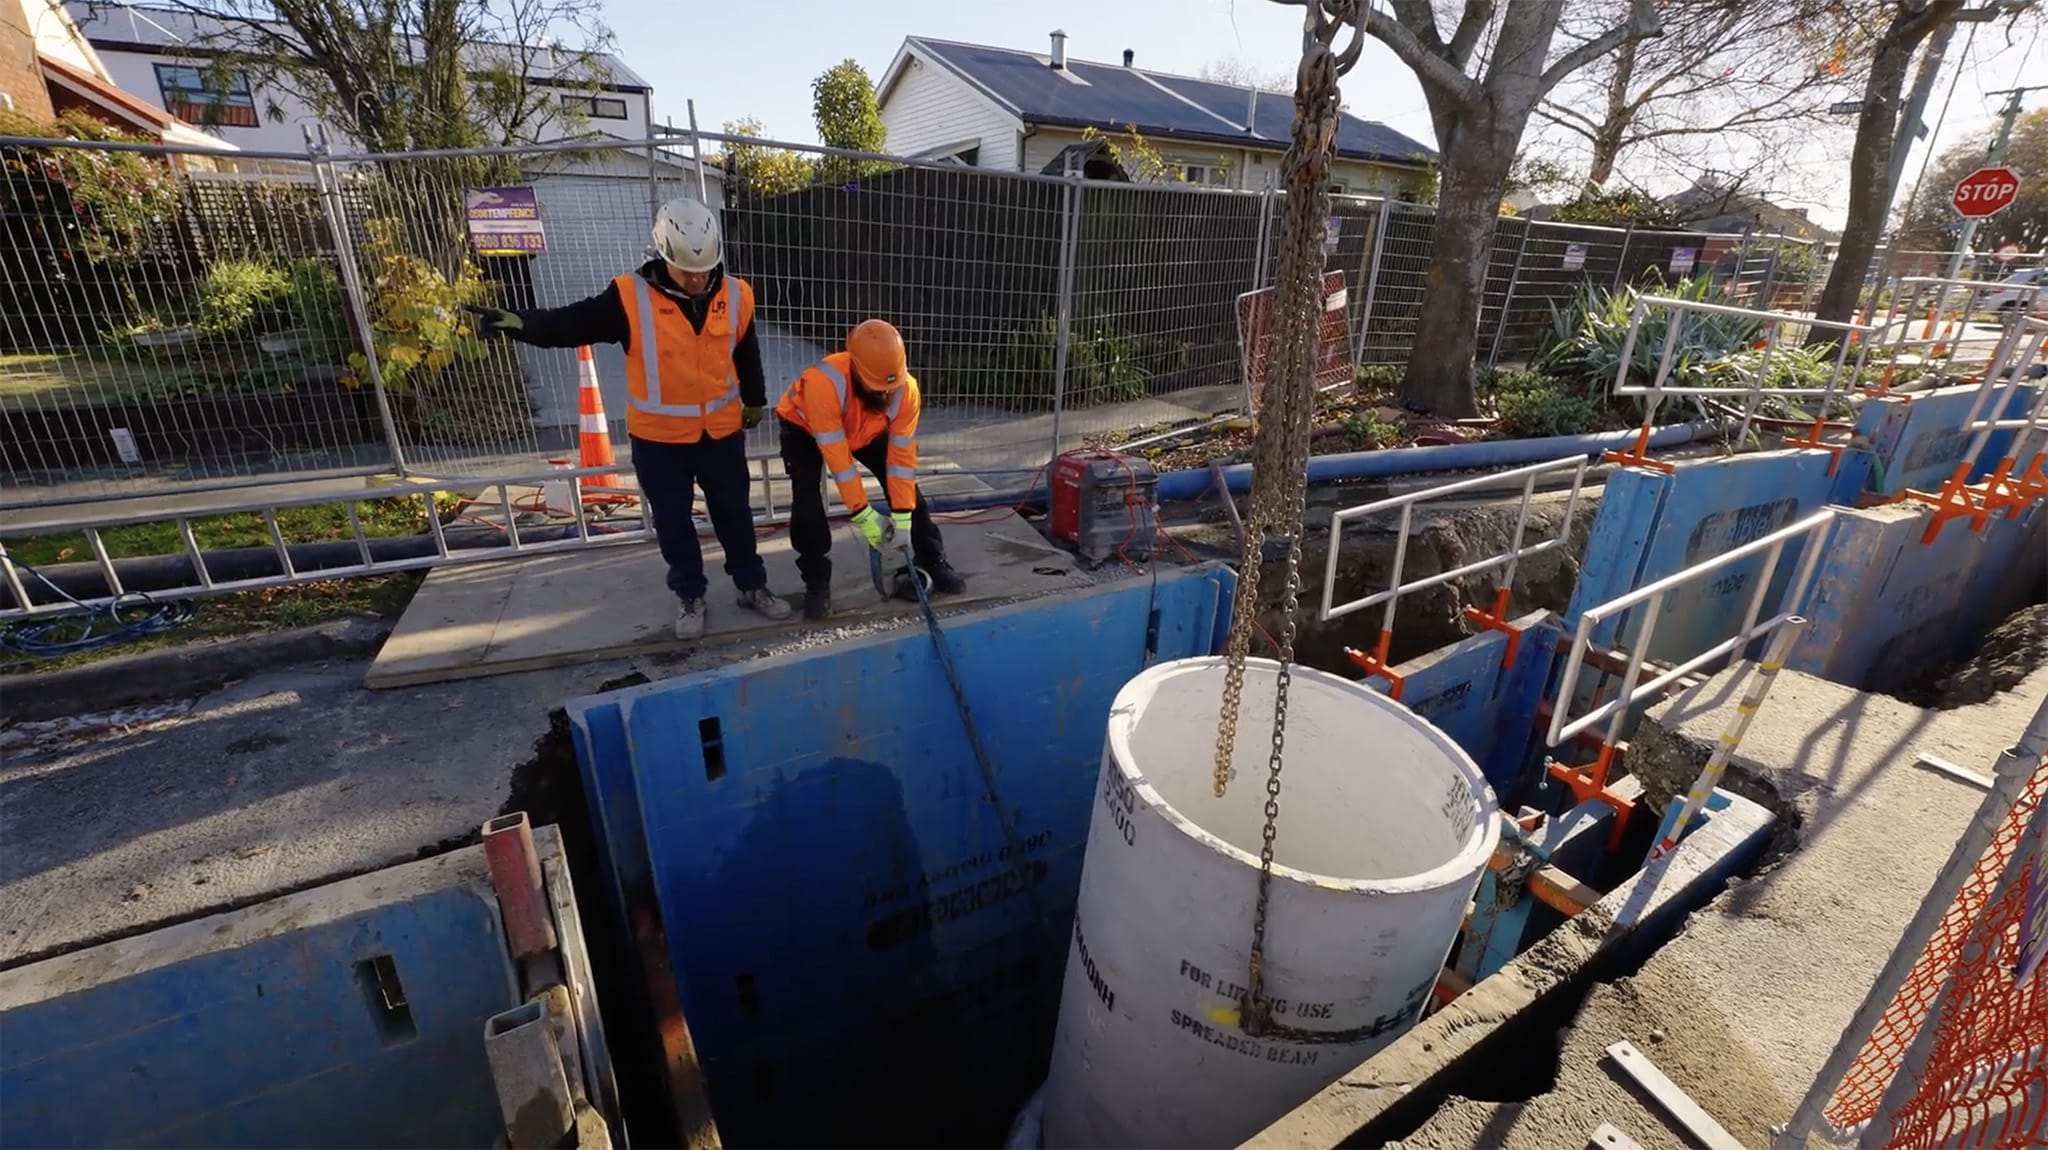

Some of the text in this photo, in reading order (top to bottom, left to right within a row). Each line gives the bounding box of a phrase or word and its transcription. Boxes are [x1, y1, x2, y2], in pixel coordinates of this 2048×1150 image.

[1957, 183, 2015, 201] STOP
[501, 234, 521, 249] 836
[1180, 959, 1212, 989] FOR
[1297, 1002, 1334, 1019] USE
[1170, 1008, 1318, 1066] SPREADER BEAM
